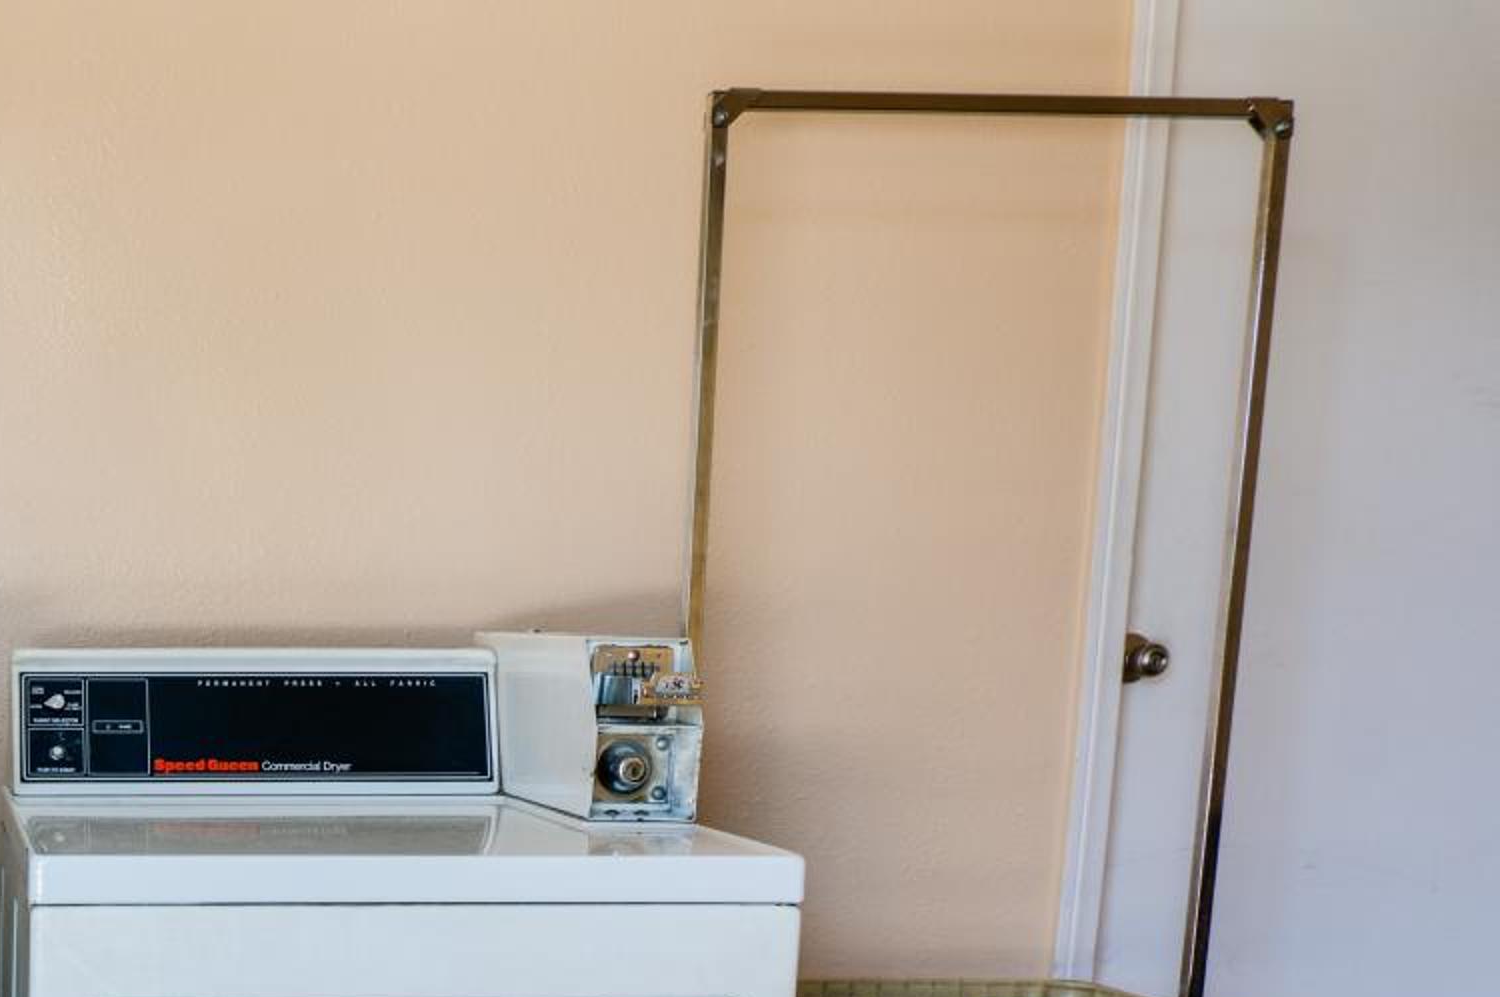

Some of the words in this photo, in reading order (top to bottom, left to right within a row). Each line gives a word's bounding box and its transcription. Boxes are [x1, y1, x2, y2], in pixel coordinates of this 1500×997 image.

[153, 758, 205, 774] Speed
[208, 758, 260, 772] Queen
[261, 760, 321, 771] Commercial
[323, 760, 352, 774] Dryer
